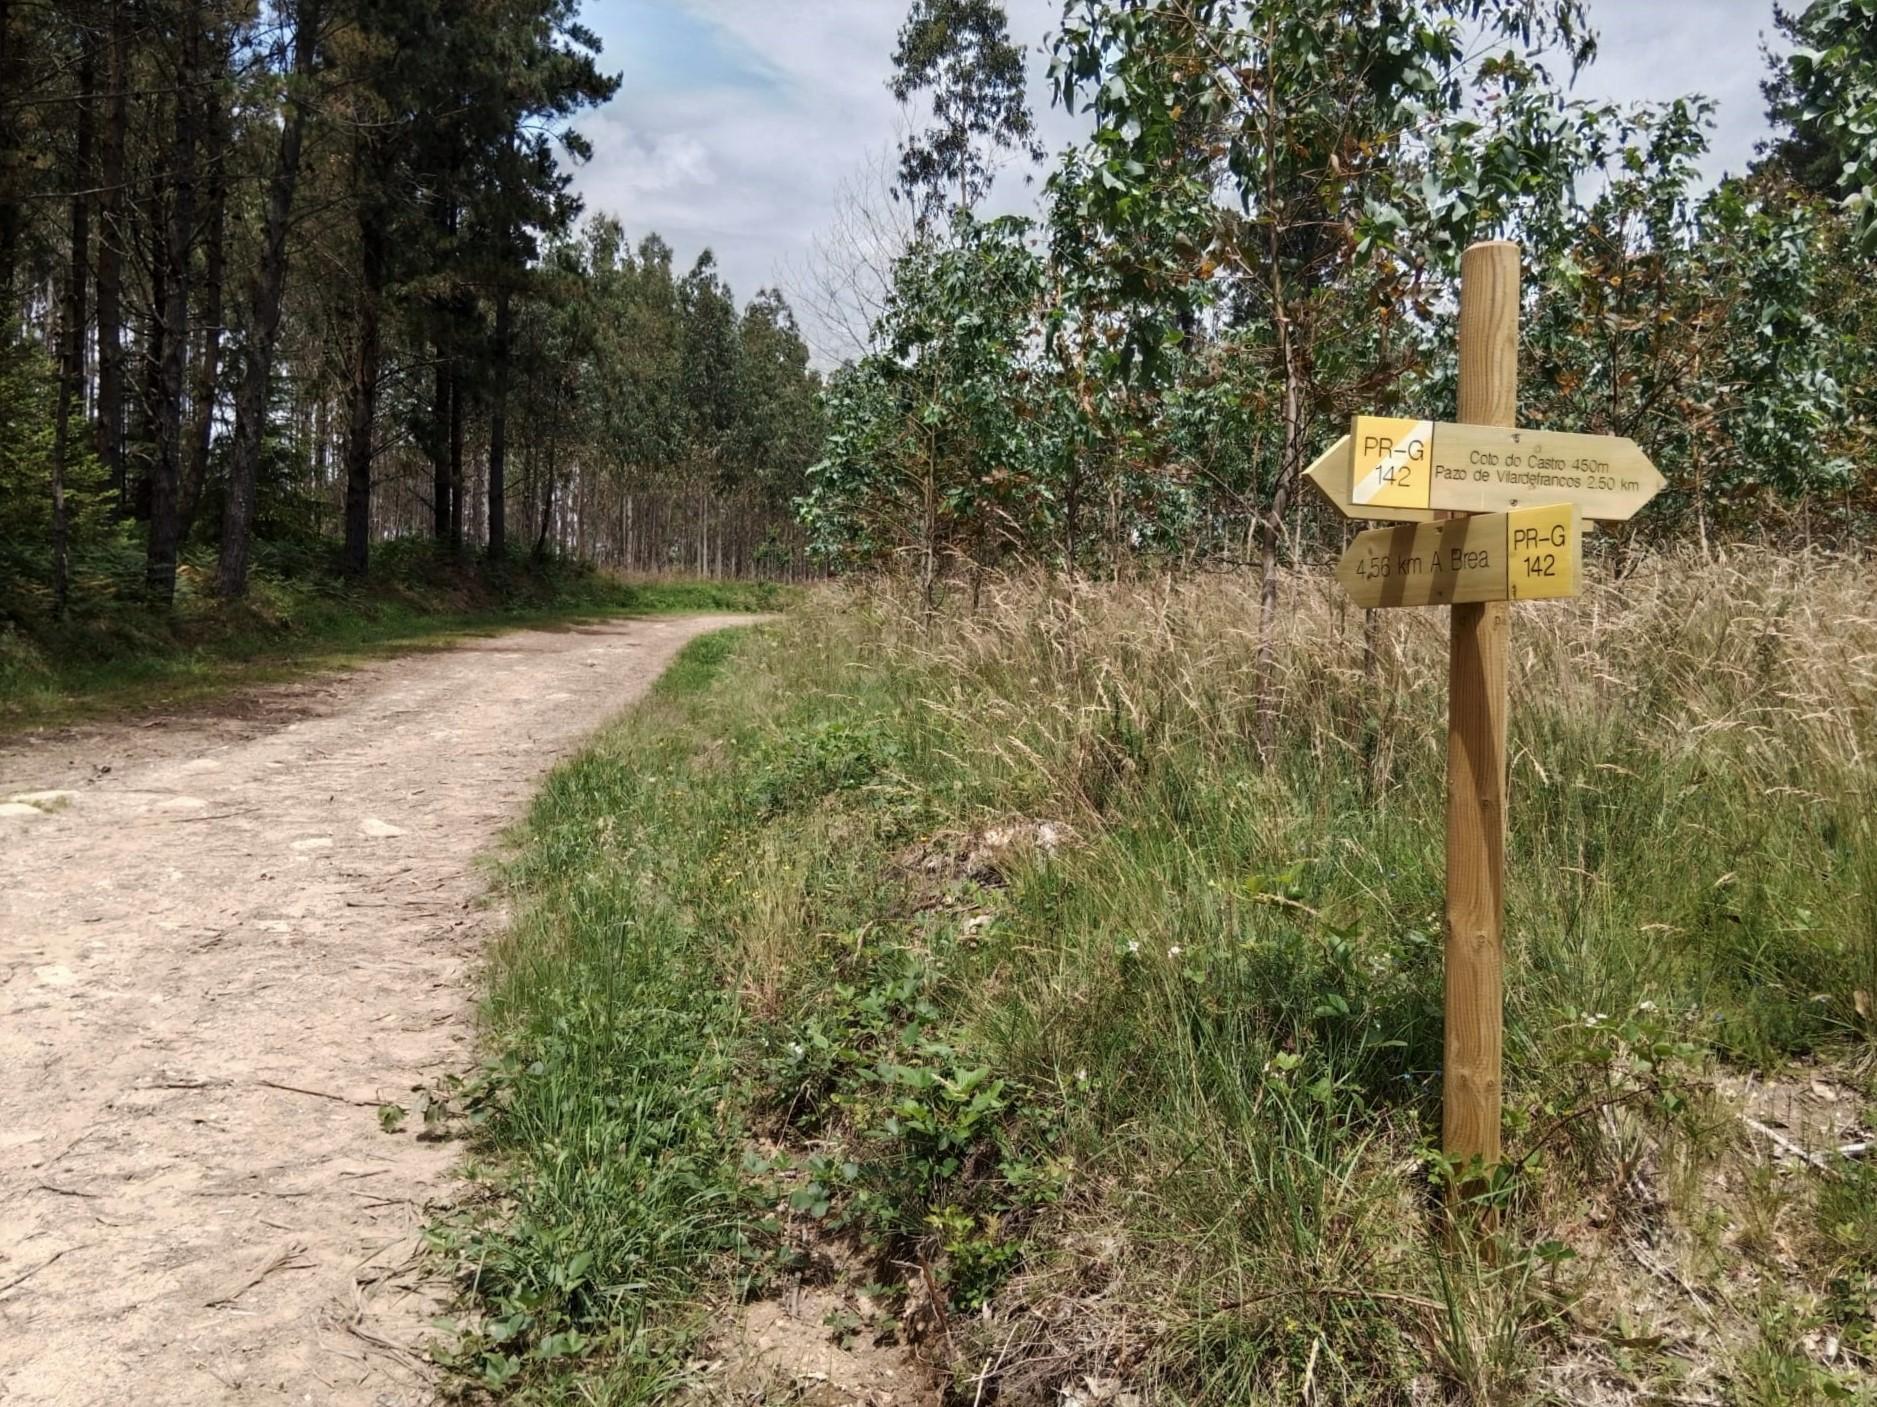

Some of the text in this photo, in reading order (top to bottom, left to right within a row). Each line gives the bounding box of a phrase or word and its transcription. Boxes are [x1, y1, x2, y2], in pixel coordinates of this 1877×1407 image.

[1364, 436, 1424, 461] PR-G
[1470, 450, 1609, 473] Coto do Castro 450m
[1375, 464, 1411, 487] 142
[1435, 465, 1639, 492] Pazo de Vilardefrancos 2.50 km
[1514, 525, 1565, 550] PR-G
[1399, 554, 1422, 575] km
[1430, 550, 1442, 573] A
[1451, 549, 1489, 571] Brea
[1523, 554, 1556, 577] 142
